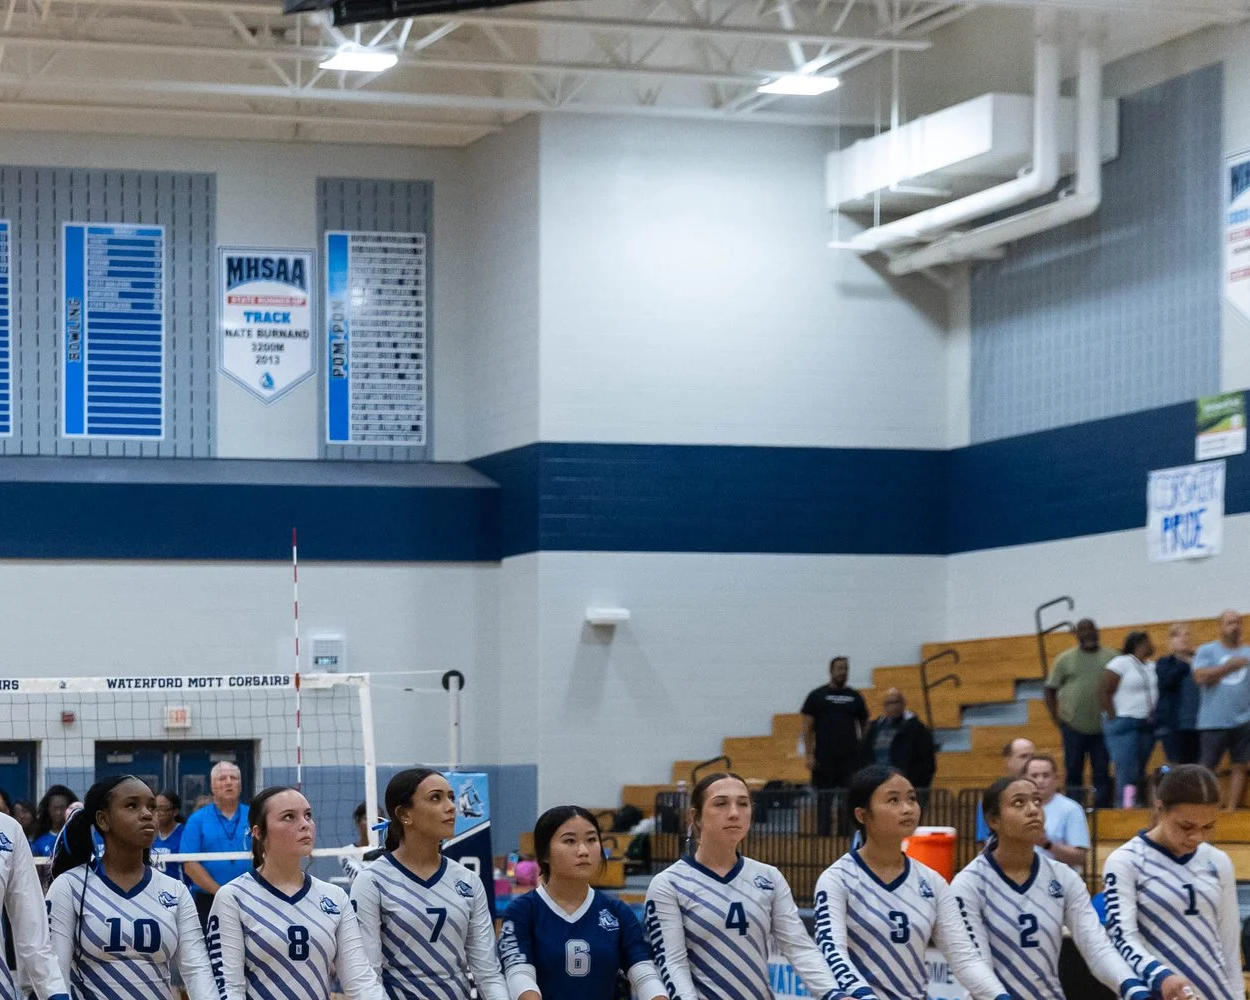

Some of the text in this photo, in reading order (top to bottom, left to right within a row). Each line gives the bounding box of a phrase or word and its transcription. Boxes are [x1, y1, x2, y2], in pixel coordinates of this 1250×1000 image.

[226, 256, 308, 292] MHSAA
[225, 328, 253, 338] NATE
[243, 311, 292, 324] TRACK
[255, 354, 281, 365] 2013
[107, 675, 290, 689] WATERFORD MOTT CORSAIRS
[1182, 883, 1199, 916] 1
[104, 917, 161, 953] 10
[426, 907, 448, 943] 7
[725, 901, 749, 936] 4
[888, 910, 910, 944] 3
[1018, 913, 1040, 948] 2
[286, 925, 310, 962] 8
[565, 938, 592, 977] 6
